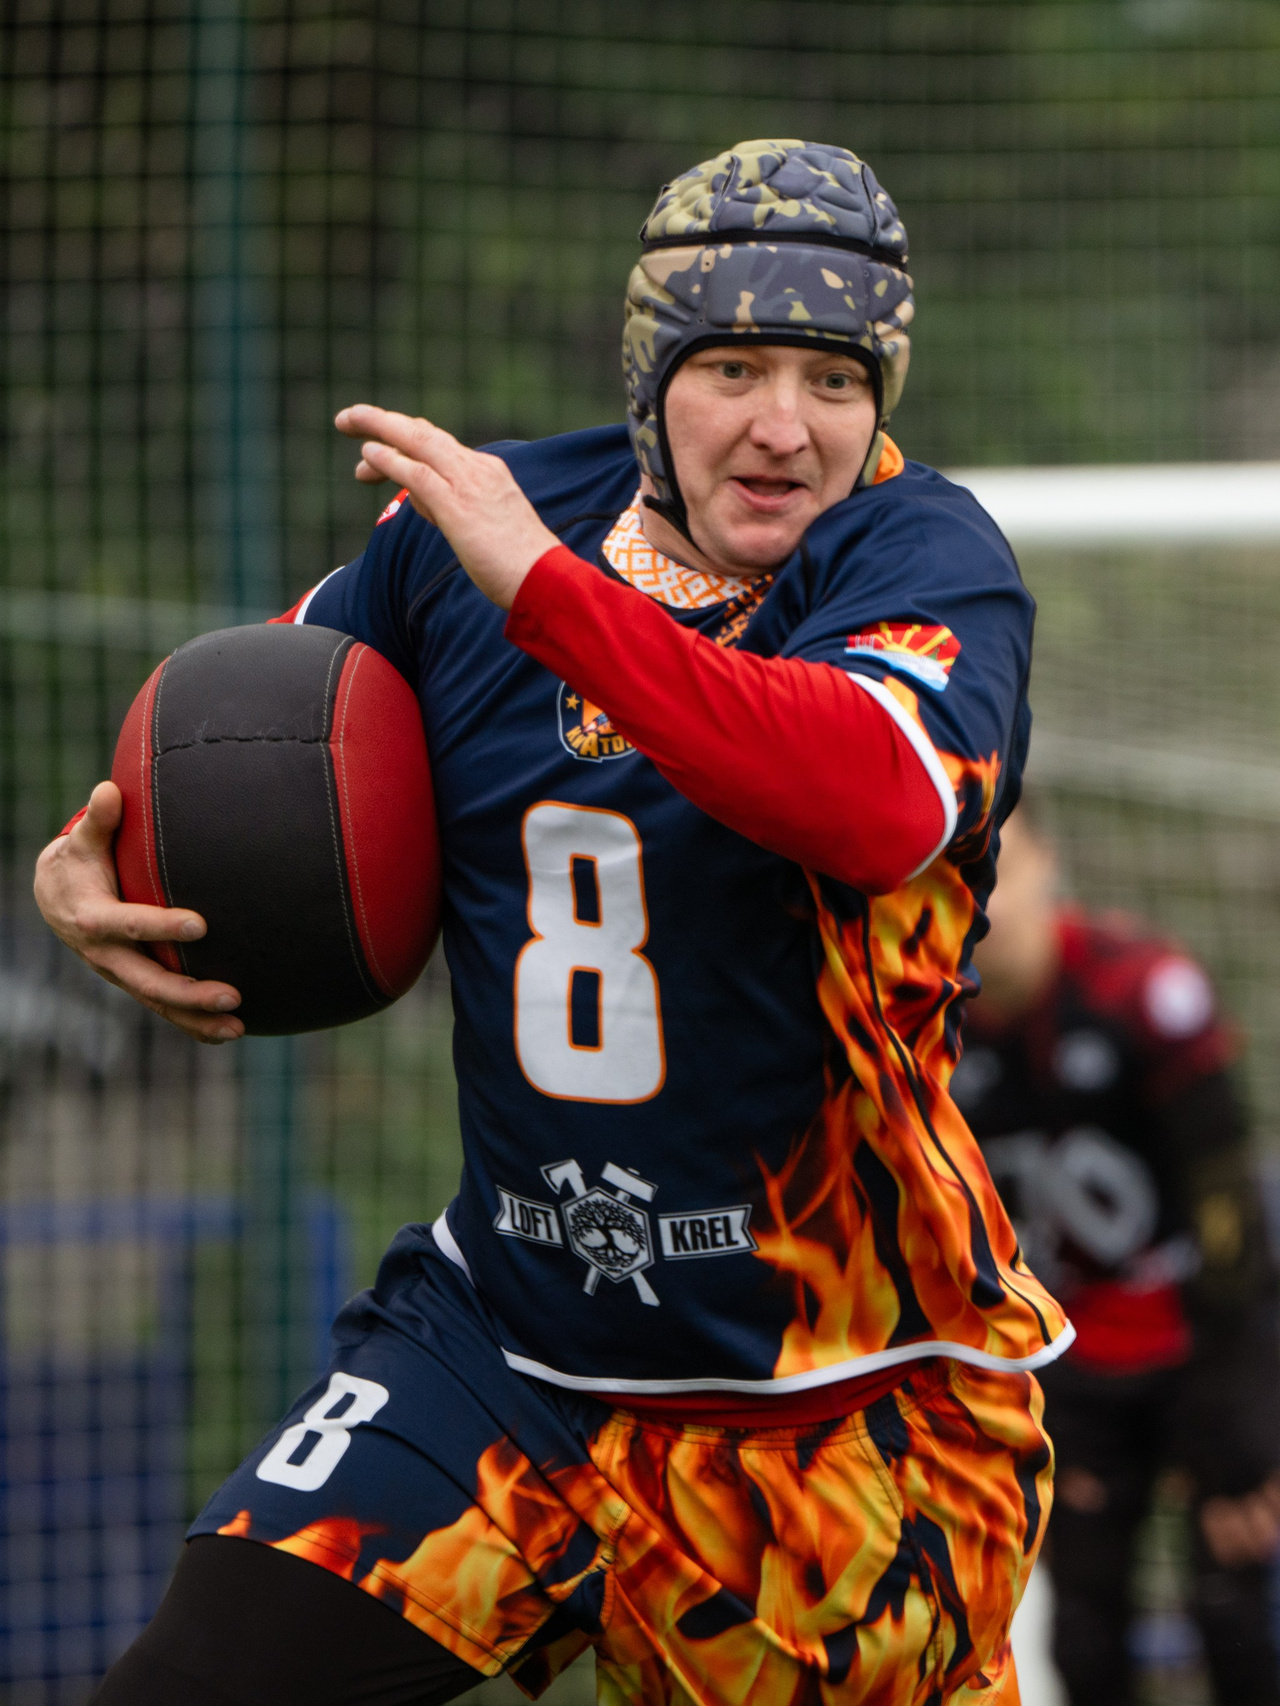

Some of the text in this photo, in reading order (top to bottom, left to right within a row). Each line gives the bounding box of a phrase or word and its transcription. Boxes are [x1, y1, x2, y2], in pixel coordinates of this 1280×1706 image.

[513, 800, 667, 1105] 8
[508, 1197, 739, 1254] LOFT KREL
[255, 1371, 390, 1492] 8
